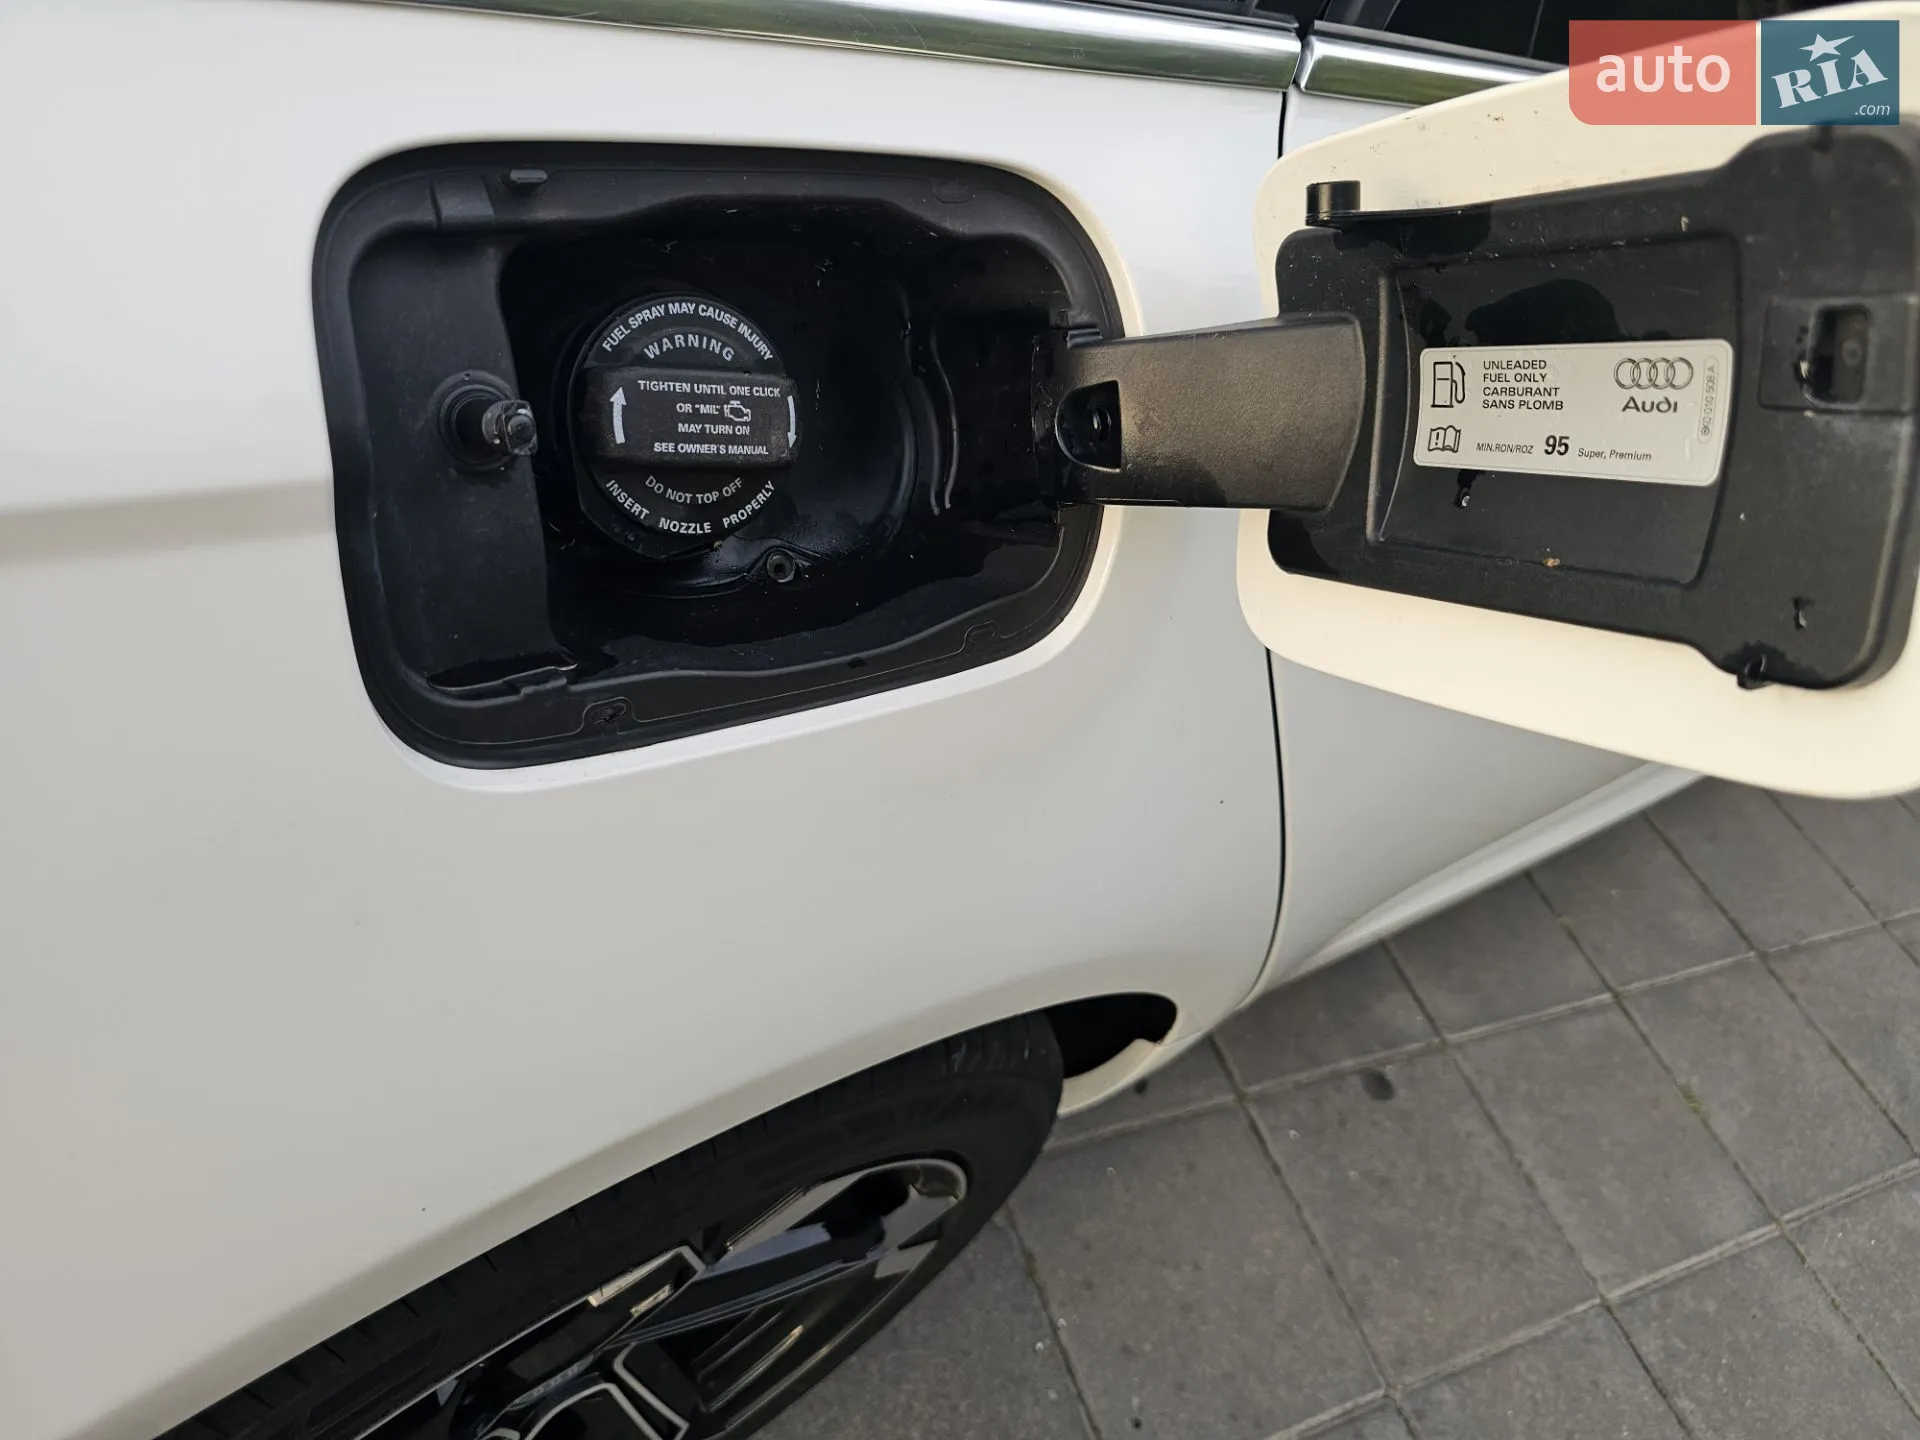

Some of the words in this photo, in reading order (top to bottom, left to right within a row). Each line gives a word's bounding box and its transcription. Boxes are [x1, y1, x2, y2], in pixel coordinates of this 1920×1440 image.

[602, 324, 631, 352] FUEL
[628, 304, 665, 329] SPRAY
[667, 302, 696, 315] MAY
[698, 304, 738, 329] CAUSE
[737, 322, 774, 361] INJURY
[643, 333, 735, 362] WARNING
[1483, 359, 1547, 371] UNLEADED
[1483, 372, 1511, 384] FUEL
[1514, 372, 1547, 384] ONLY
[637, 379, 691, 393] TIGHTEN
[694, 383, 727, 396] UNTIL
[729, 385, 751, 396] ONE
[752, 386, 781, 397] CLICK
[1483, 386, 1560, 397] CARBURANT
[676, 402, 693, 414] OR
[1482, 399, 1515, 411] SANS
[1518, 400, 1564, 411] PLOMB
[1621, 395, 1679, 414] Audi
[677, 423, 702, 433] MAY
[704, 424, 733, 435] TURN
[735, 425, 750, 435] ON
[653, 442, 676, 453] SEE
[677, 443, 727, 455] OWNER'S
[728, 446, 769, 455] MANUAL
[1476, 442, 1534, 455] MIN.RON/ROZ
[1543, 434, 1570, 456] 95
[1577, 447, 1607, 460] Super,
[1609, 449, 1652, 461] Premium
[645, 475, 665, 494] DO
[665, 488, 693, 504] NOT
[695, 491, 720, 505] TOP
[722, 477, 744, 498] OFF
[605, 479, 650, 520] INSERT
[658, 517, 712, 534] NOZZLE
[722, 480, 775, 529] PROPERLY
